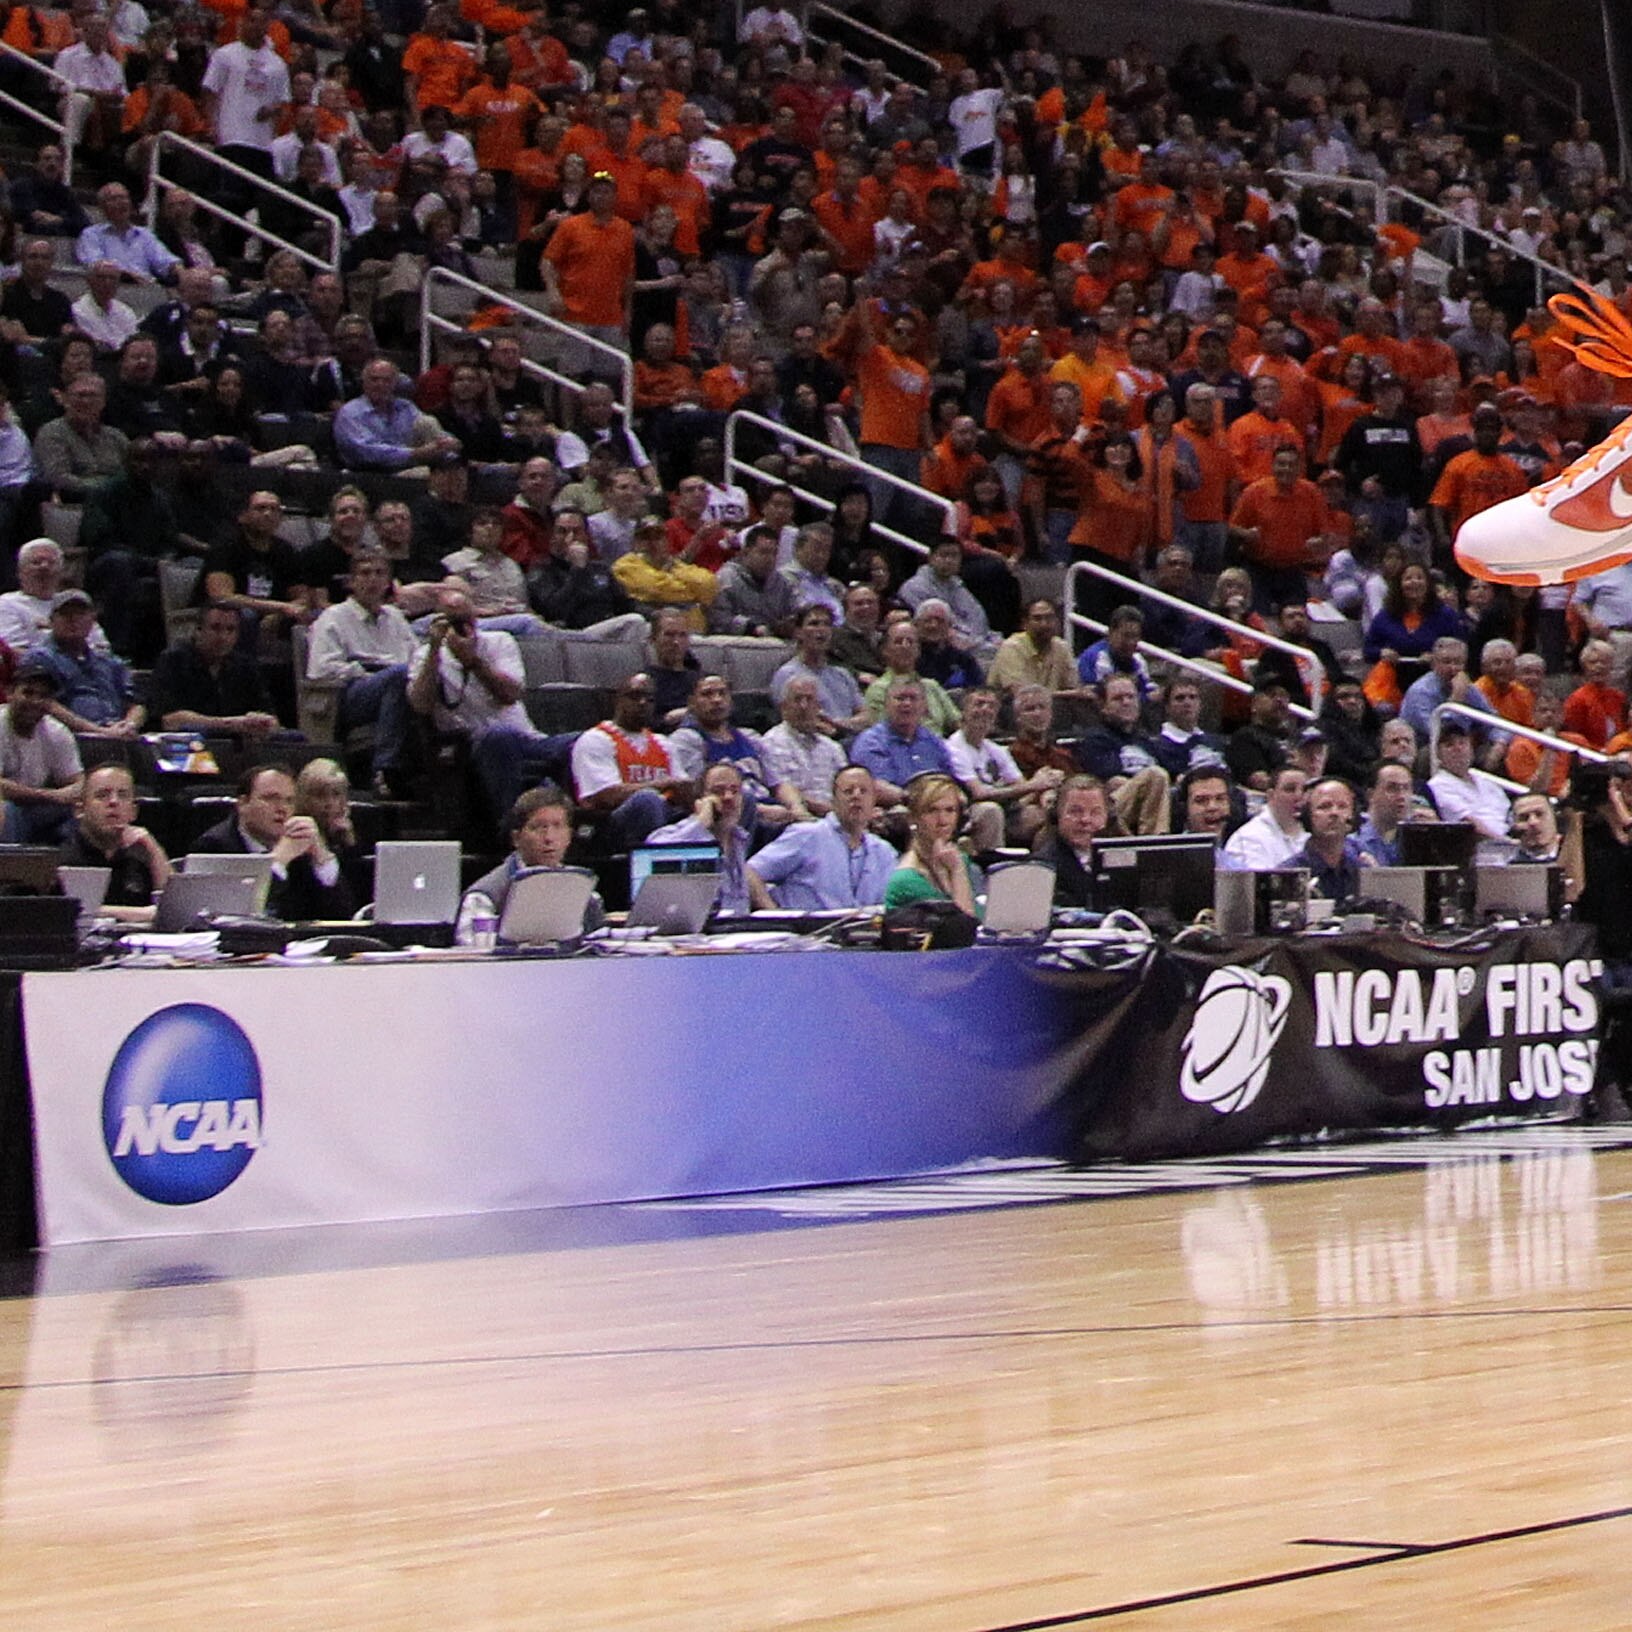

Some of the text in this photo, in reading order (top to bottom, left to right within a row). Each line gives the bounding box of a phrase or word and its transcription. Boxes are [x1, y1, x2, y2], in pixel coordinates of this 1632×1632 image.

[1424, 1048, 1501, 1108] SAN
[1509, 1039, 1600, 1102] JOS
[113, 1098, 260, 1158] NCAA
